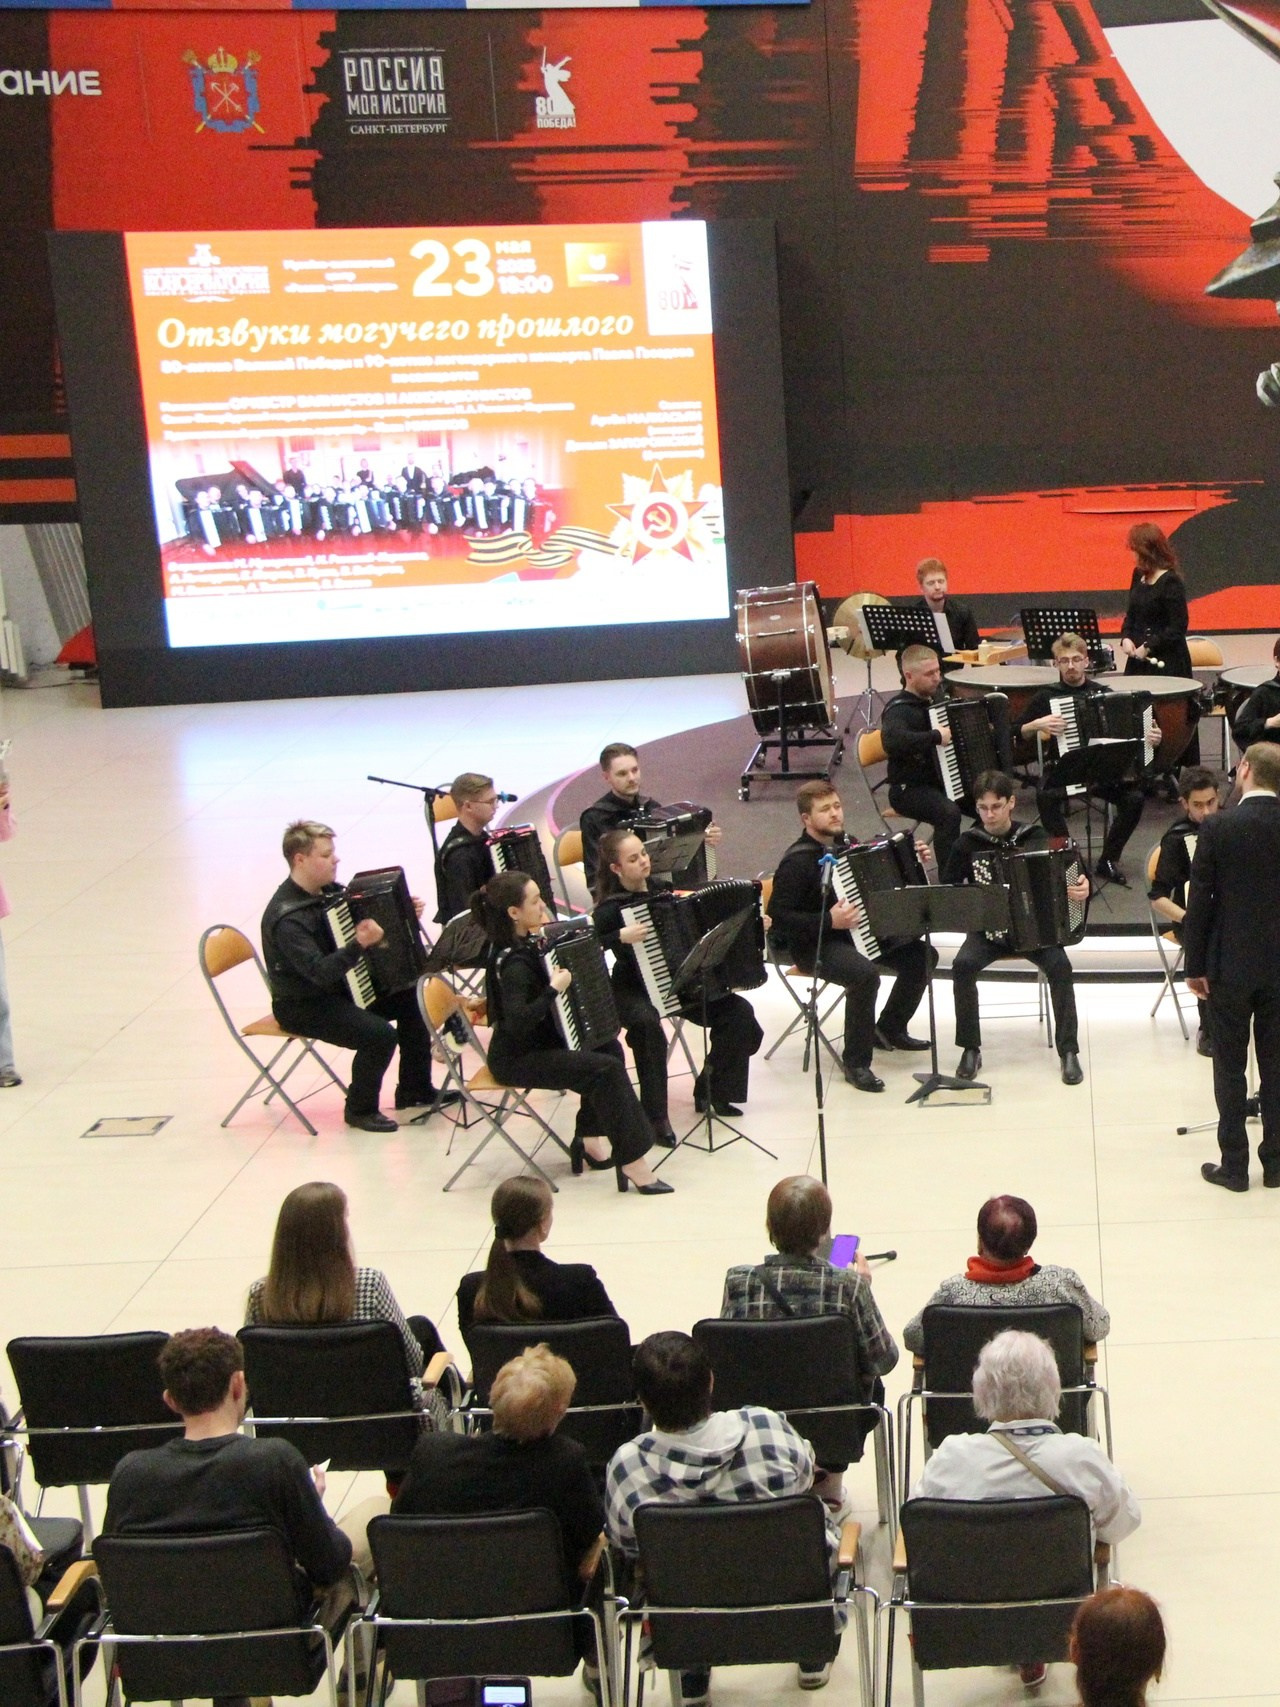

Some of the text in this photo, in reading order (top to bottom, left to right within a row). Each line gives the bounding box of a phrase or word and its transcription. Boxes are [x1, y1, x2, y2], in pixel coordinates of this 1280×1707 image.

[343, 56, 446, 92] РОССИЯ
[346, 93, 447, 116] МОЯ ИСТОРИЯ
[350, 123, 449, 136] САНКТ-ПЕТЕРБУРГ
[537, 117, 577, 129] ПОБЕДА!
[411, 238, 495, 298] 23
[157, 314, 634, 353] Отзвуки могучего прошлого
